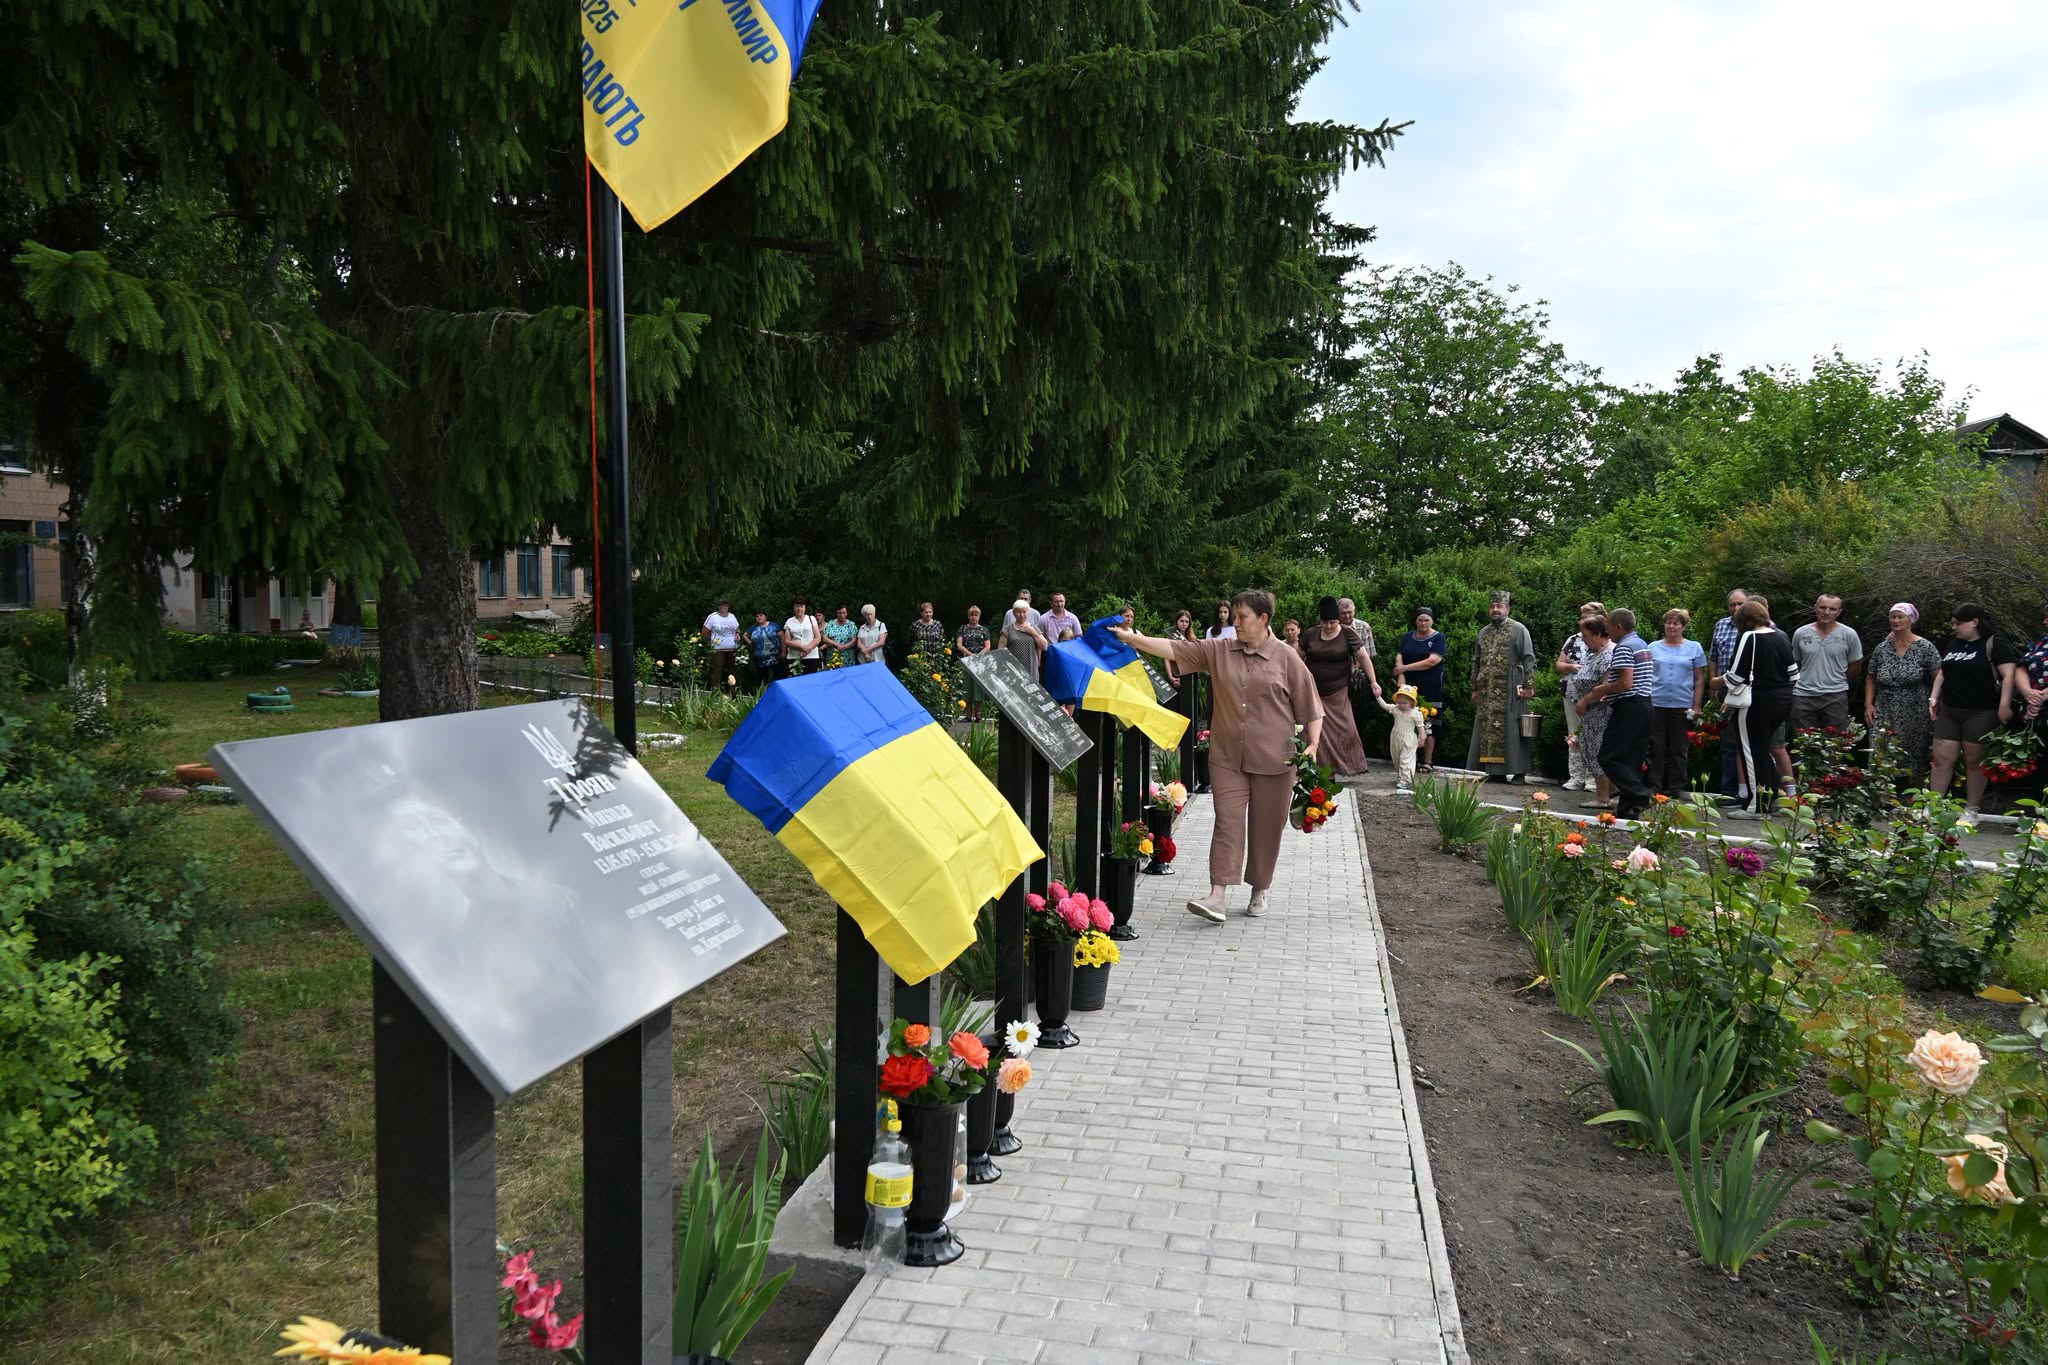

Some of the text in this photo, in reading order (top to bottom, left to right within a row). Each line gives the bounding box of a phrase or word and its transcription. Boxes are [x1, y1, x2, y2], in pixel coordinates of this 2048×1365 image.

[581, 33, 645, 146] РАЮТЬ
[543, 774, 617, 809] Троян
[576, 804, 633, 829] Микола
